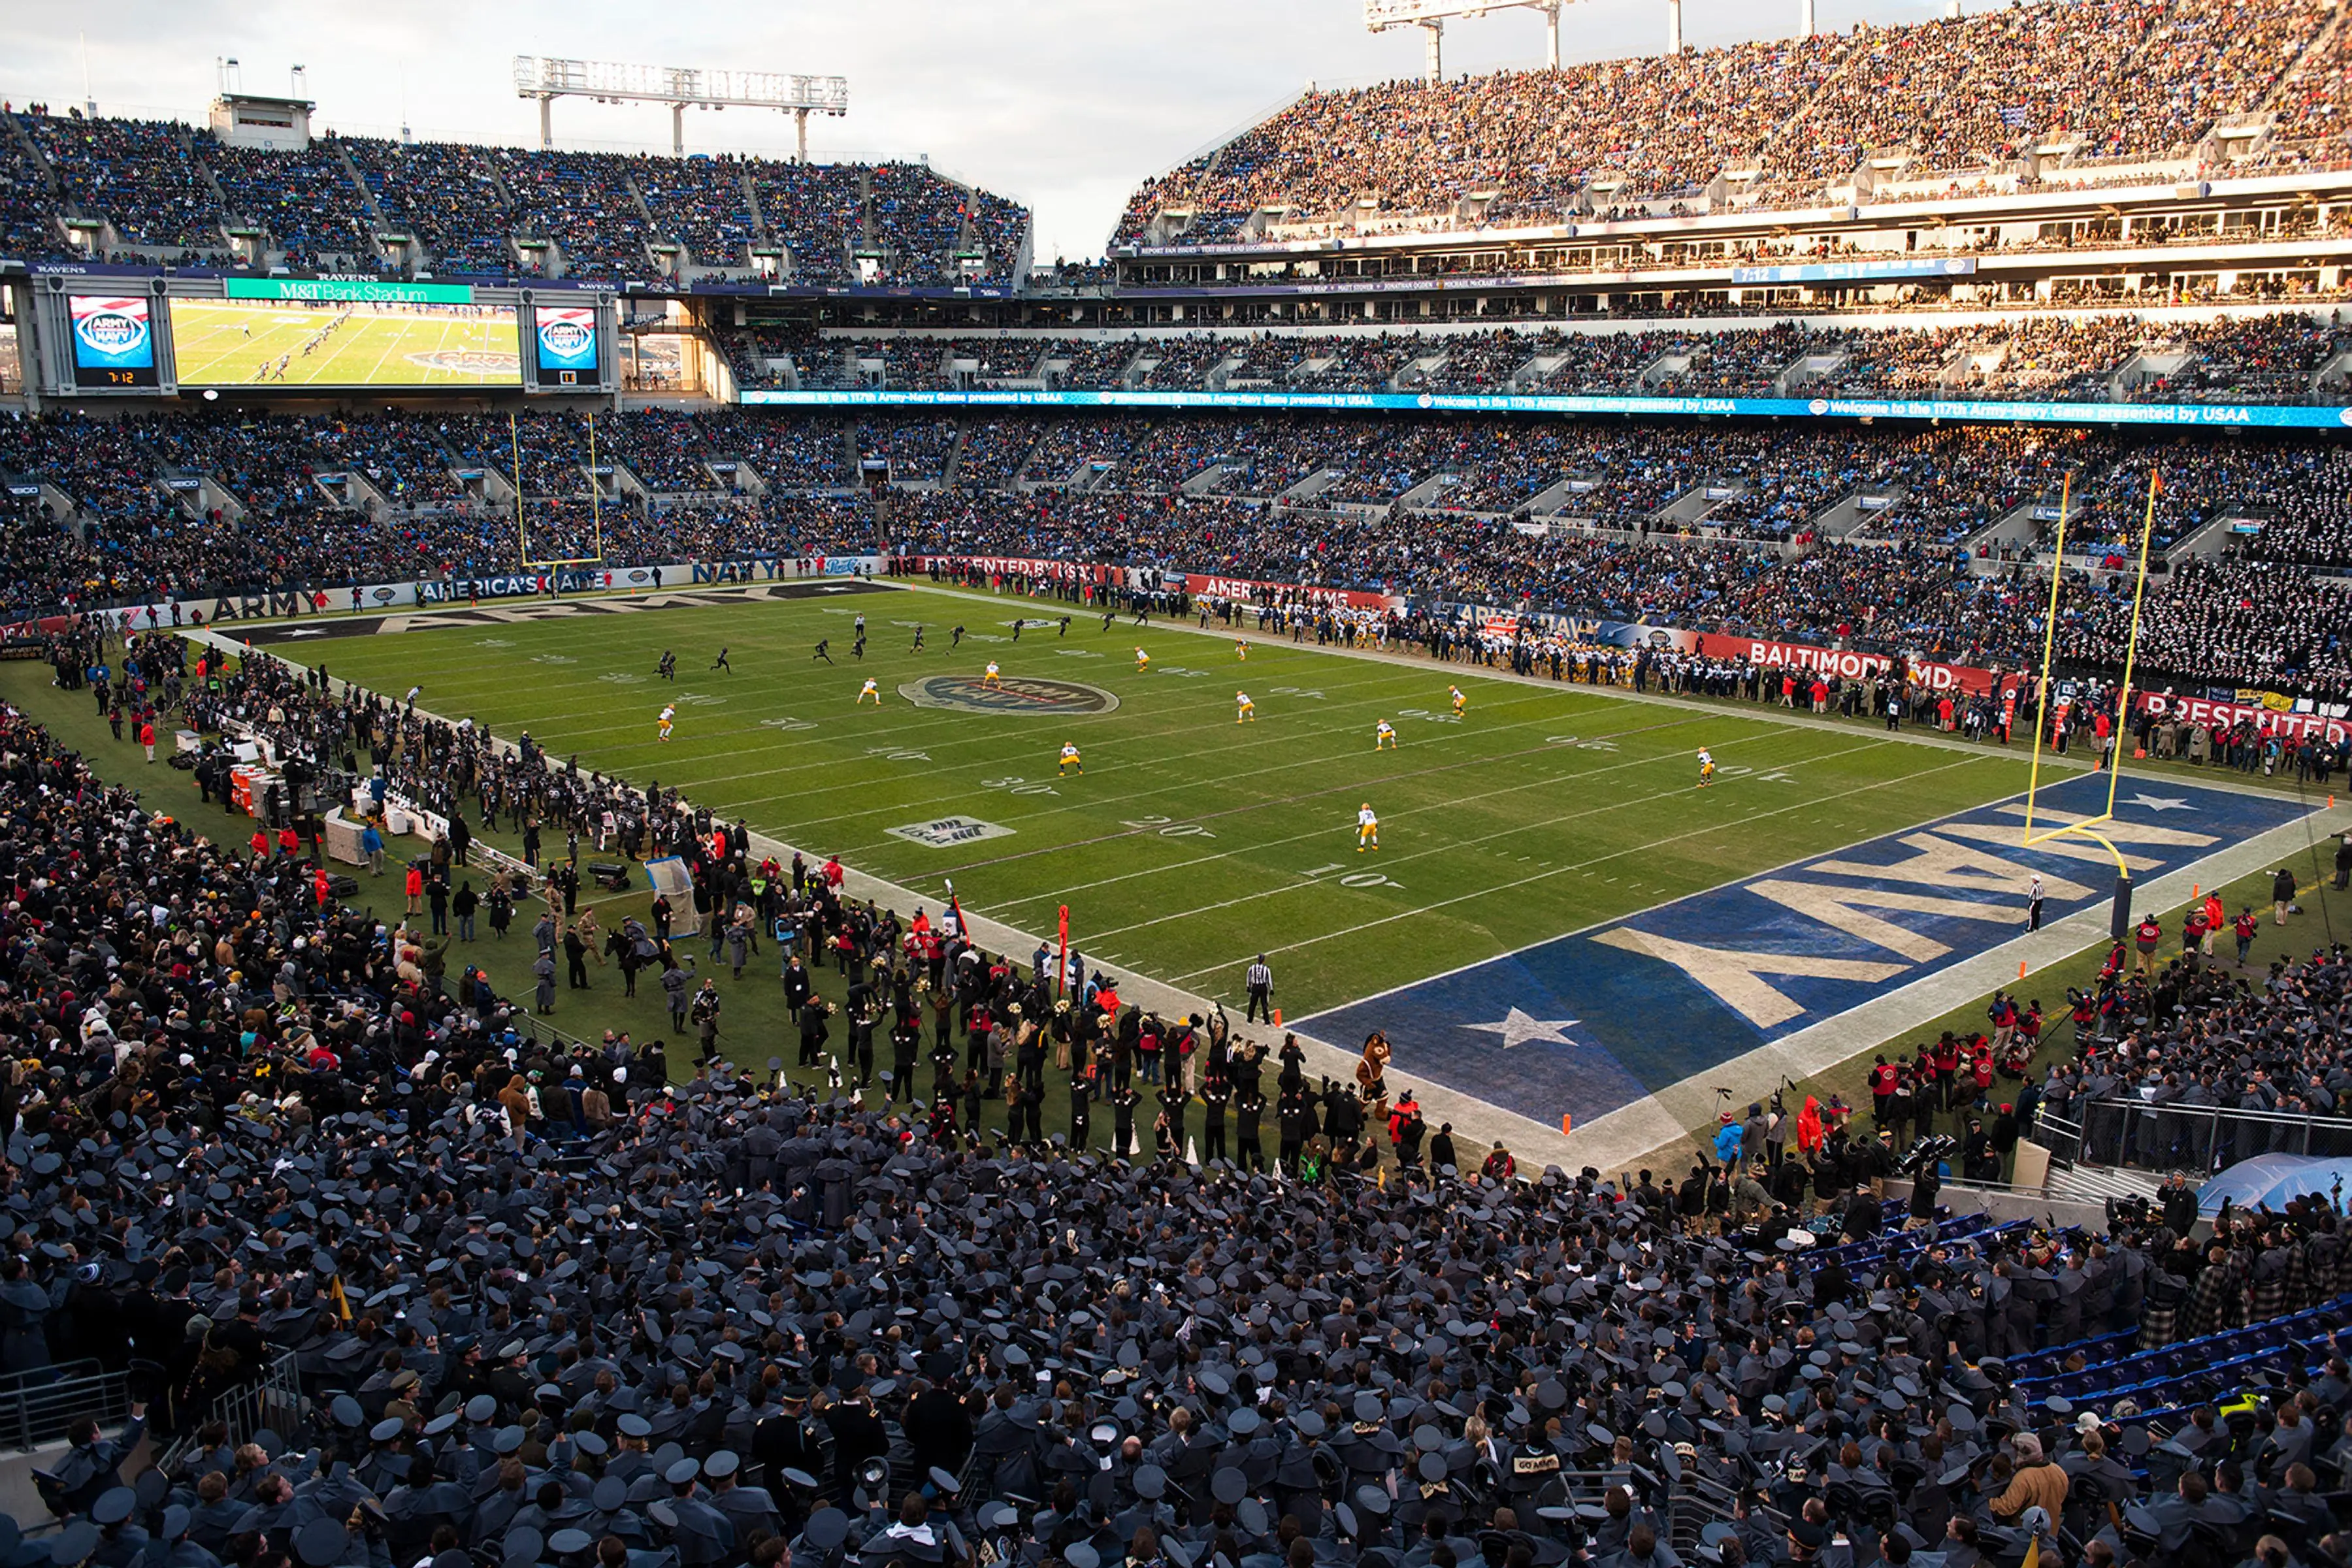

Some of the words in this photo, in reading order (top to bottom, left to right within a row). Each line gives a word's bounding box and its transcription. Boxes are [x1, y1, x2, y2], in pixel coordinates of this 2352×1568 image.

[317, 273, 378, 282] RAVENS
[280, 282, 321, 299] M&T
[323, 284, 363, 301] Bank
[363, 284, 428, 302] Stadium
[93, 318, 128, 328] ARMY
[553, 325, 580, 335] ARMY
[95, 331, 129, 342] NAVY
[818, 392, 828, 402] to
[831, 392, 849, 402] the
[879, 393, 934, 403] Army-Navy
[936, 393, 966, 402] Game
[968, 393, 1018, 404] presented
[1020, 393, 1032, 404] by
[1034, 394, 1063, 402] USAA
[1213, 395, 1262, 406] Army-Navy
[1264, 395, 1288, 404] Game
[1289, 395, 1333, 407] presented
[1335, 396, 1346, 407] by
[1348, 396, 1373, 406] USAA
[1434, 396, 1477, 406] Welcome
[1479, 397, 1490, 407] to
[1492, 397, 1508, 407] the
[1511, 397, 1535, 408] 117th
[1537, 399, 1593, 410] Army-Navy
[1596, 399, 1626, 409] Game
[1629, 399, 1684, 412] presented
[1686, 400, 1699, 412] by
[1703, 400, 1736, 411] USAA
[1831, 401, 1889, 413] Welcome
[1891, 402, 1904, 414] to
[1908, 402, 1930, 414] the
[1934, 403, 1967, 415] 117th
[1970, 404, 2048, 418] Army-Navy
[2052, 406, 2095, 419] Game
[2098, 407, 2174, 421] presented
[2178, 408, 2197, 422] by
[2203, 408, 2249, 421] USAA
[211, 589, 319, 621] ARMY
[375, 587, 786, 633] ARMY
[981, 776, 1053, 796] 30
[1119, 815, 1203, 837] 20
[1298, 863, 1388, 887] 10
[1589, 804, 2222, 1029] NAVY
[1519, 1461, 1533, 1469] GO
[1534, 1459, 1556, 1469] ARMY
